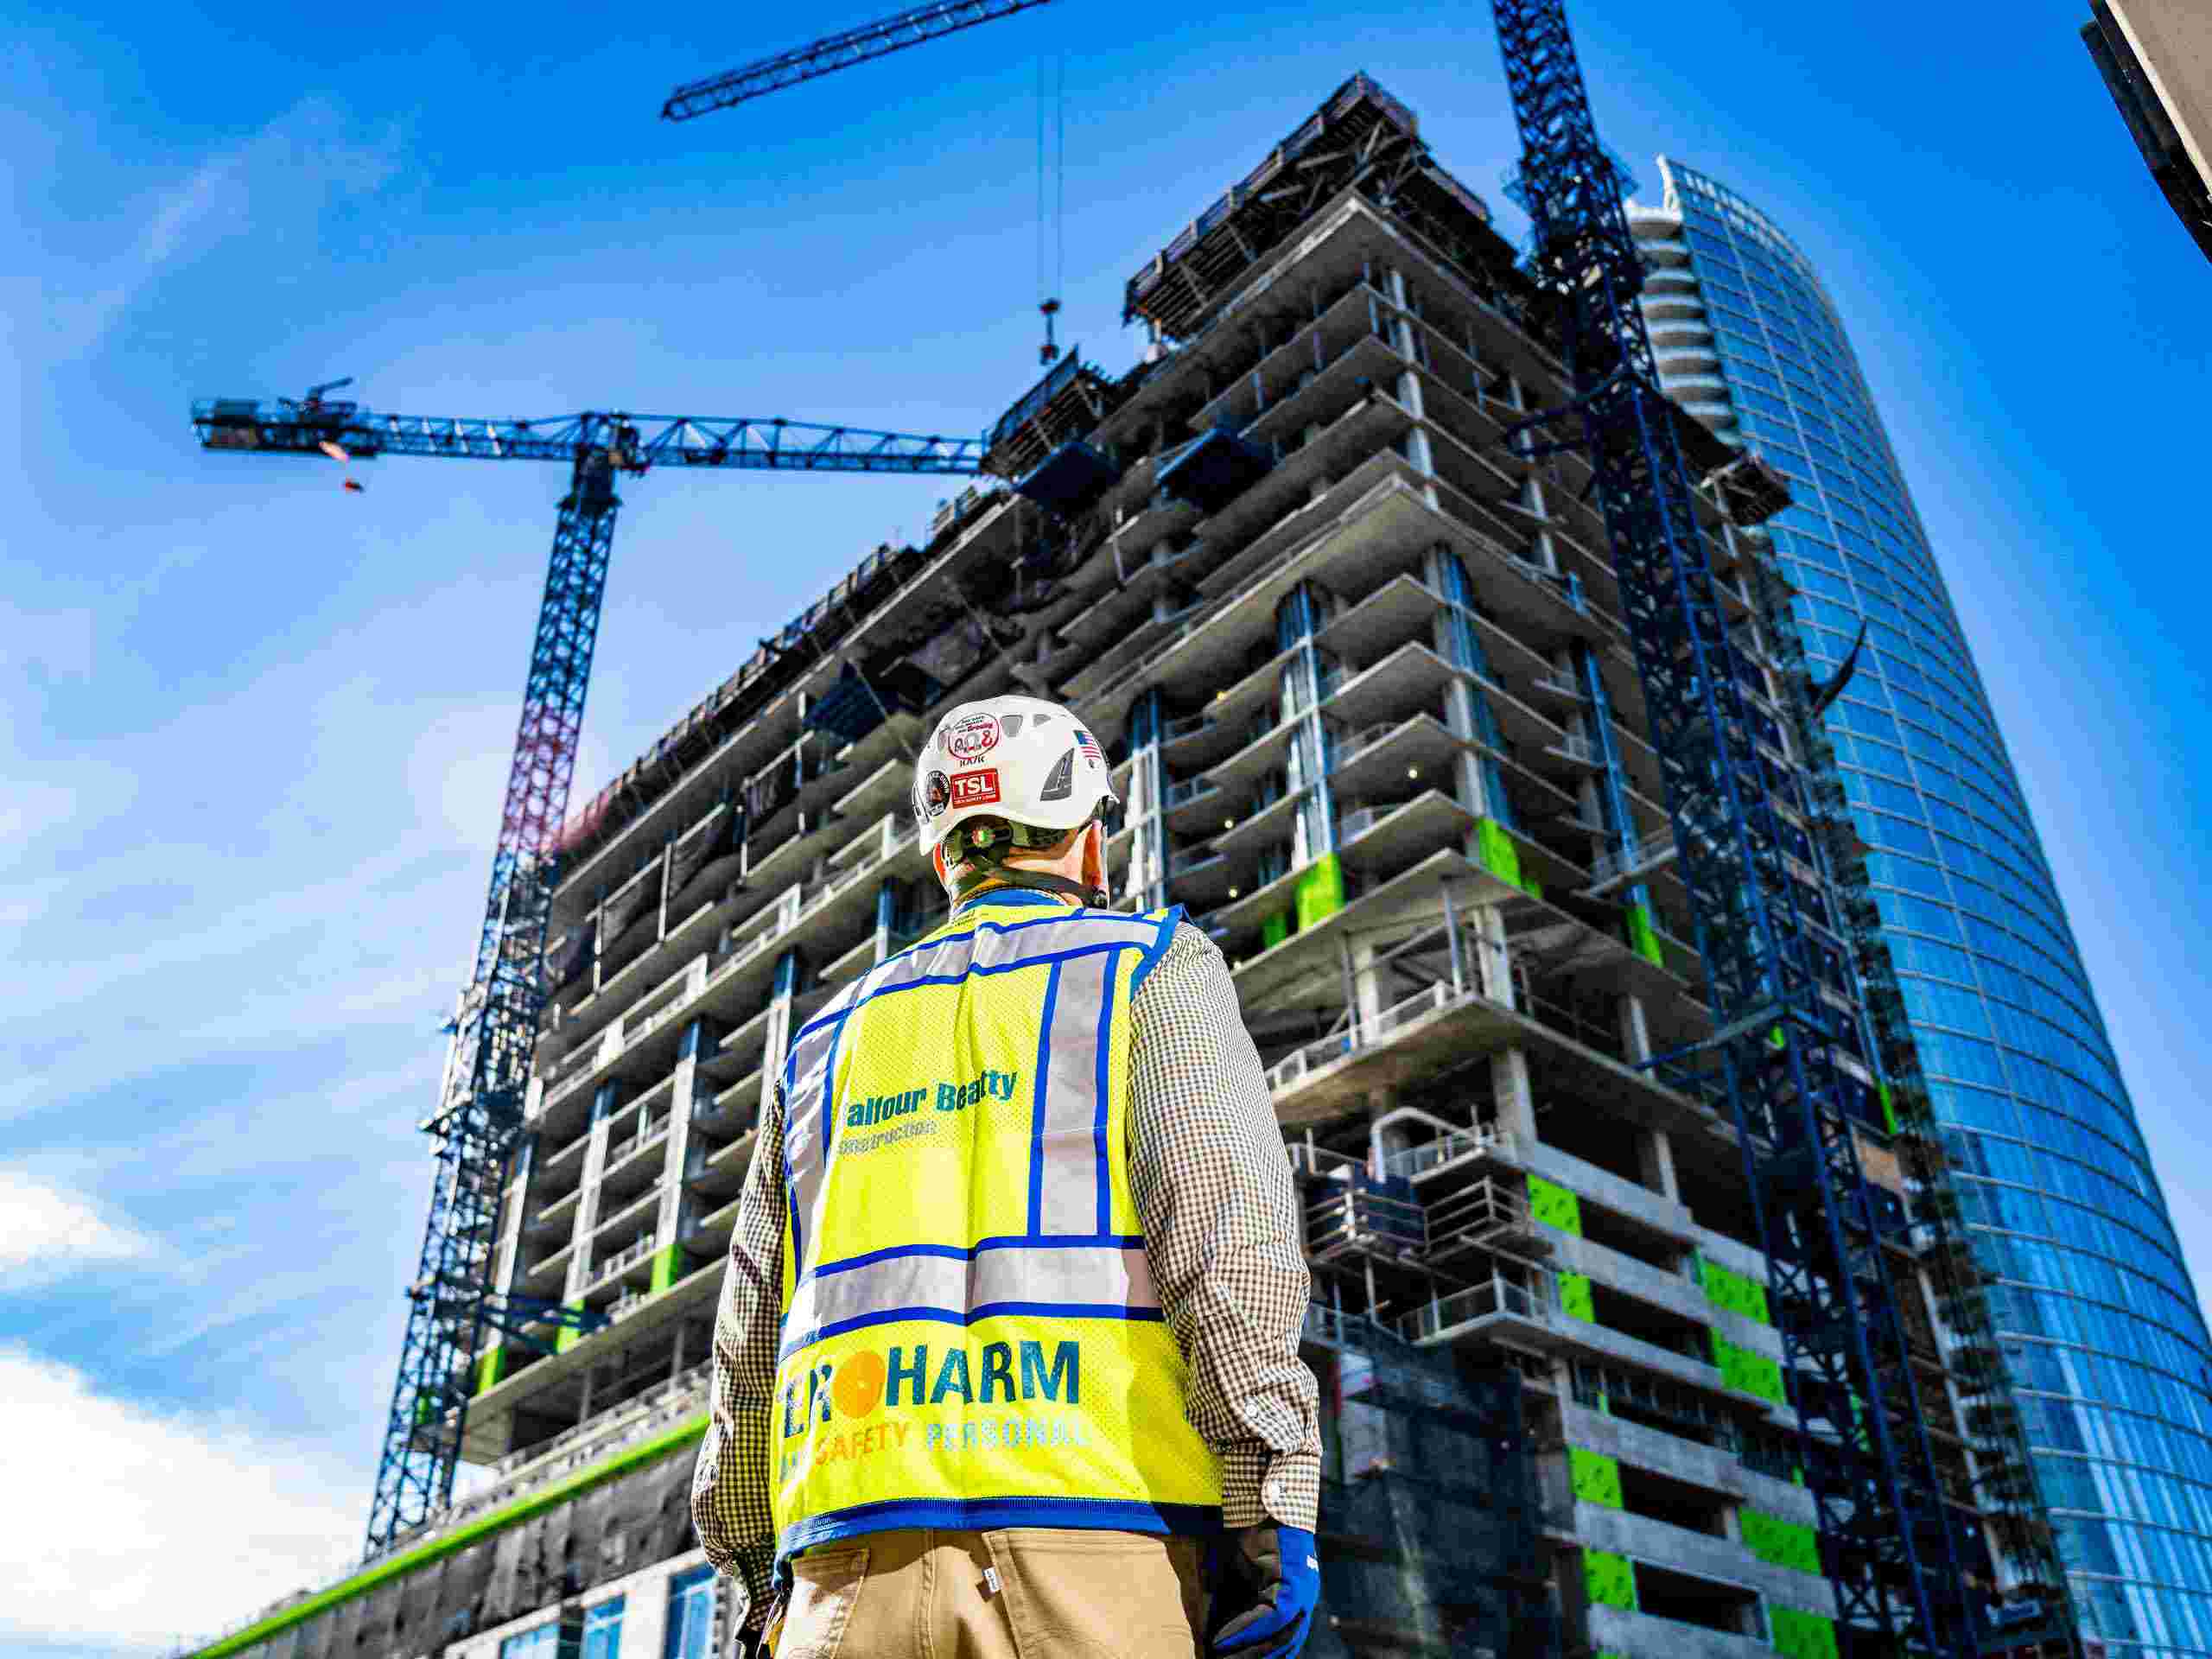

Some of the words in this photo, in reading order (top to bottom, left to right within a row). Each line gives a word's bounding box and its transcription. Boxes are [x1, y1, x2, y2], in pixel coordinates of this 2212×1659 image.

[954, 776, 995, 797] TSL
[936, 1069, 1017, 1112] Beatty
[885, 1340, 1080, 1407] HARM
[815, 1421, 907, 1466] SAFETY
